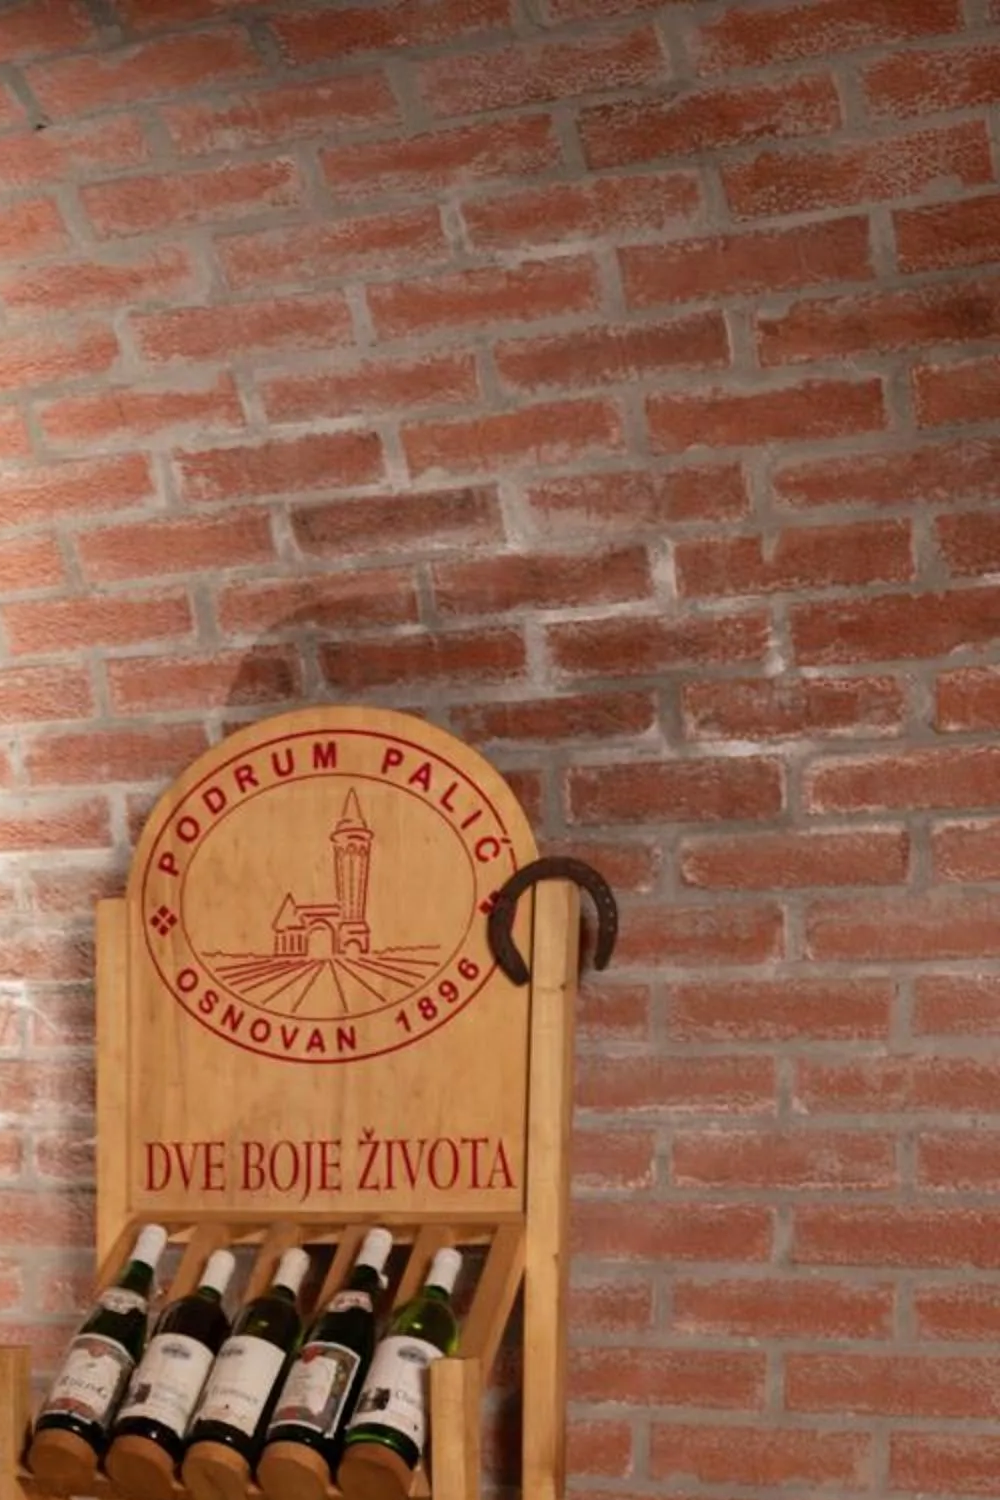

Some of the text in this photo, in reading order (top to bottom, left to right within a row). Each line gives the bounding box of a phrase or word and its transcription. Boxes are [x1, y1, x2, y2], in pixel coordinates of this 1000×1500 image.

[157, 740, 513, 879] PODRUM PALIĆ
[176, 956, 481, 1055] OSNOVAN 1896
[144, 1126, 519, 1203] DVE BOJE ŽIVOTA
